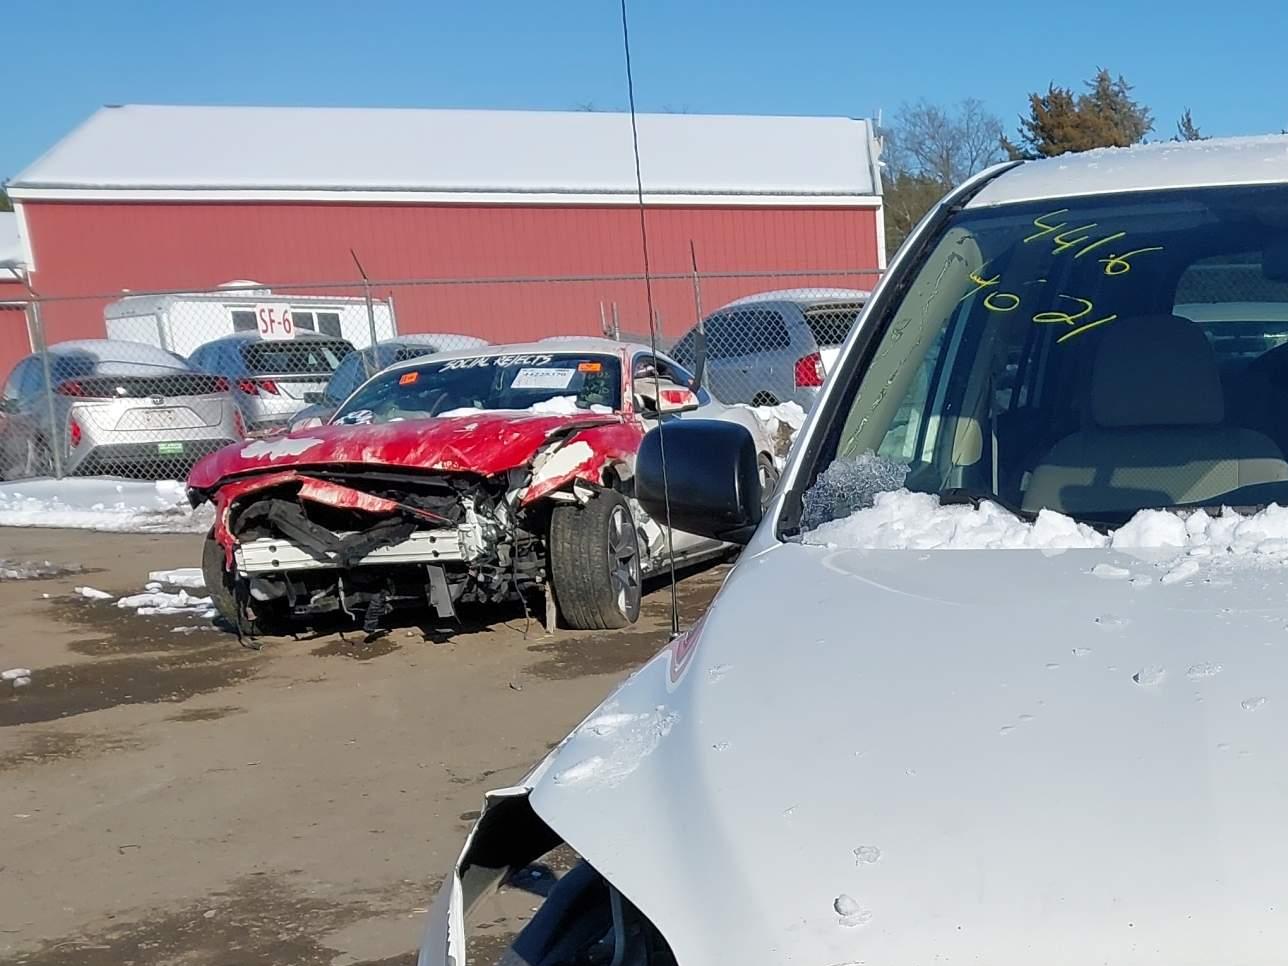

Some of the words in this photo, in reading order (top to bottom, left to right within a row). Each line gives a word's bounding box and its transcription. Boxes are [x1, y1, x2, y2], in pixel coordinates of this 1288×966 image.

[259, 308, 292, 335] SF-6
[438, 356, 491, 374] SOCIAL
[493, 353, 554, 369] REJECTS
